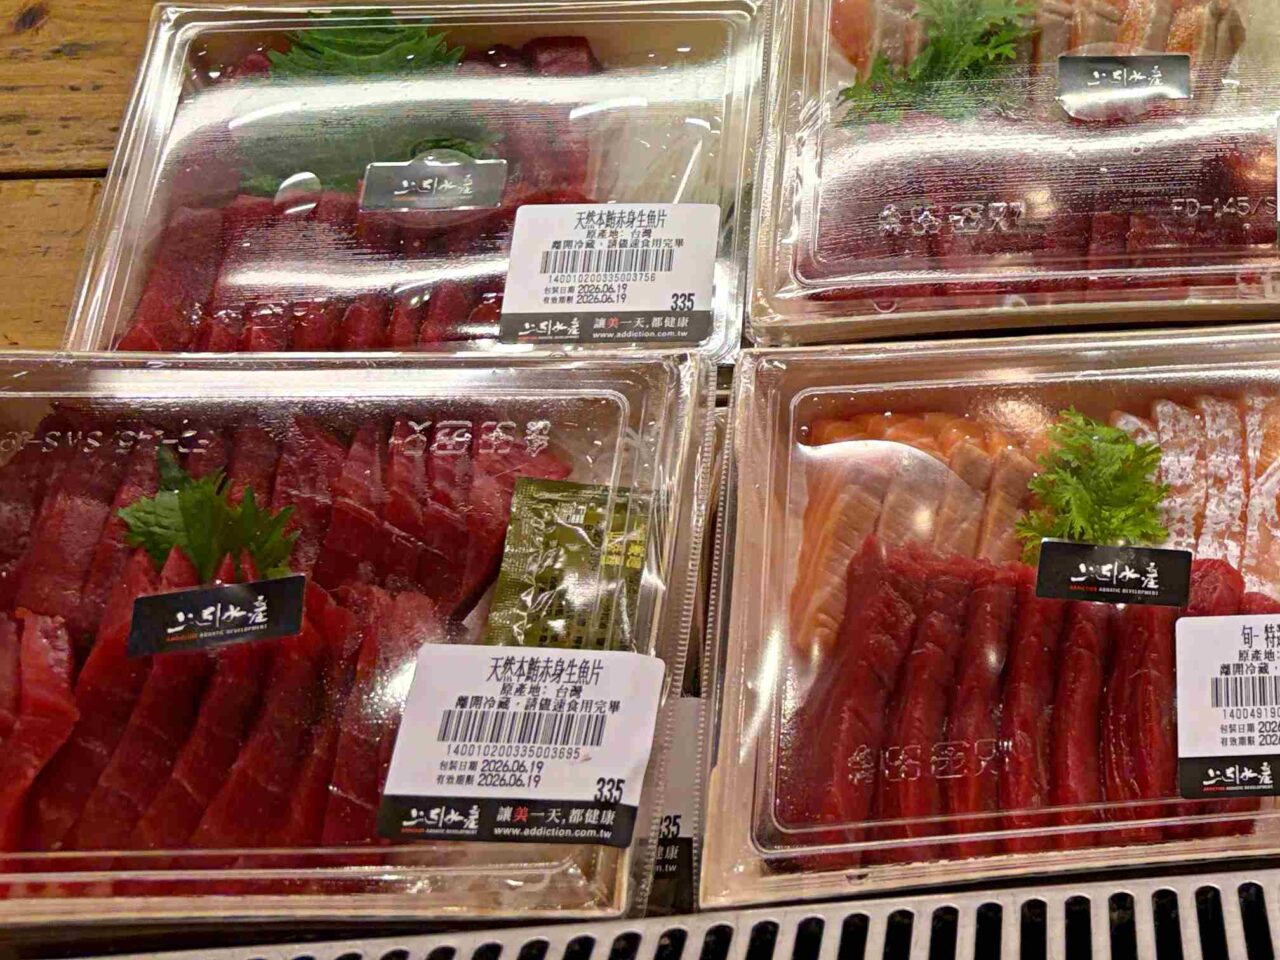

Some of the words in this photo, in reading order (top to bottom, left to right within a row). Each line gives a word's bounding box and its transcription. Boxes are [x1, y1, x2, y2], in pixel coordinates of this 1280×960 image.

[578, 284, 627, 293] 2026.06.19
[577, 294, 627, 304] 2026.06.19
[671, 293, 695, 311] 335
[487, 657, 603, 686] 天然本鮪赤身生魚片
[448, 744, 580, 759] 140010200335003695
[481, 760, 544, 773] 2026.06.19
[478, 774, 540, 787] 2026.06.19
[594, 778, 624, 803] 335
[494, 827, 612, 839] www.addiction.com.tw
[659, 815, 681, 839] 35
